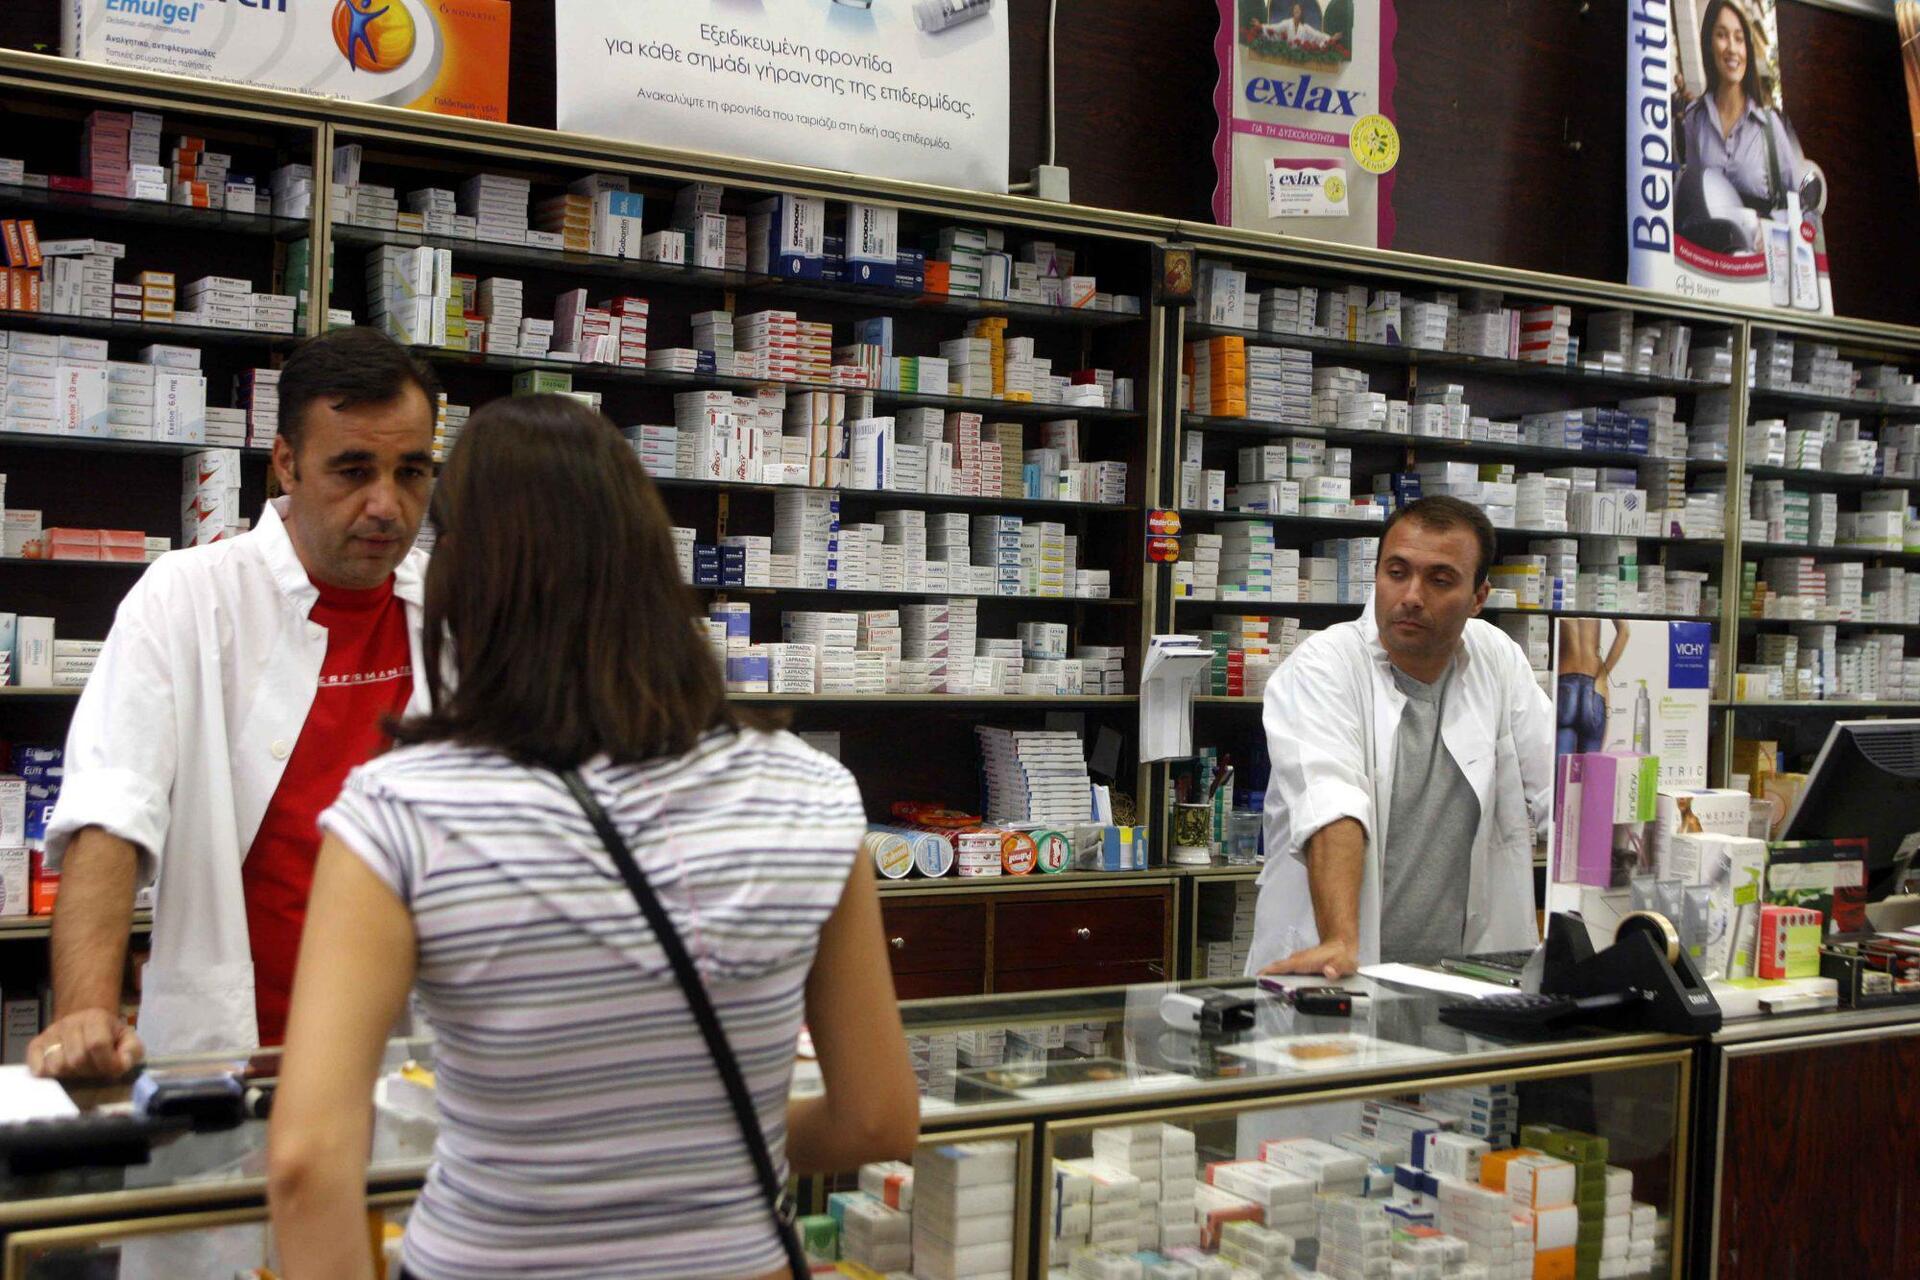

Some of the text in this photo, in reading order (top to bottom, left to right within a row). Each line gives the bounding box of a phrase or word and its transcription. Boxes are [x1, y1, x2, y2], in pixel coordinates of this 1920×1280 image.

[700, 23, 893, 74] Εξειδικευμένη φροντίδα
[605, 37, 975, 119] για κάθε σημάδι γήρανσης της επιδερμίδας.
[637, 87, 705, 109] Ανακαλύψτε
[707, 101, 719, 112] τη
[720, 102, 771, 118] φροντίδα
[772, 111, 794, 122] που
[839, 121, 858, 135] στη
[859, 123, 879, 138] δική
[880, 129, 900, 143] σας
[68, 408, 77, 430] Exelon
[167, 411, 176, 436] Exelon
[1675, 643, 1704, 656] VICHY
